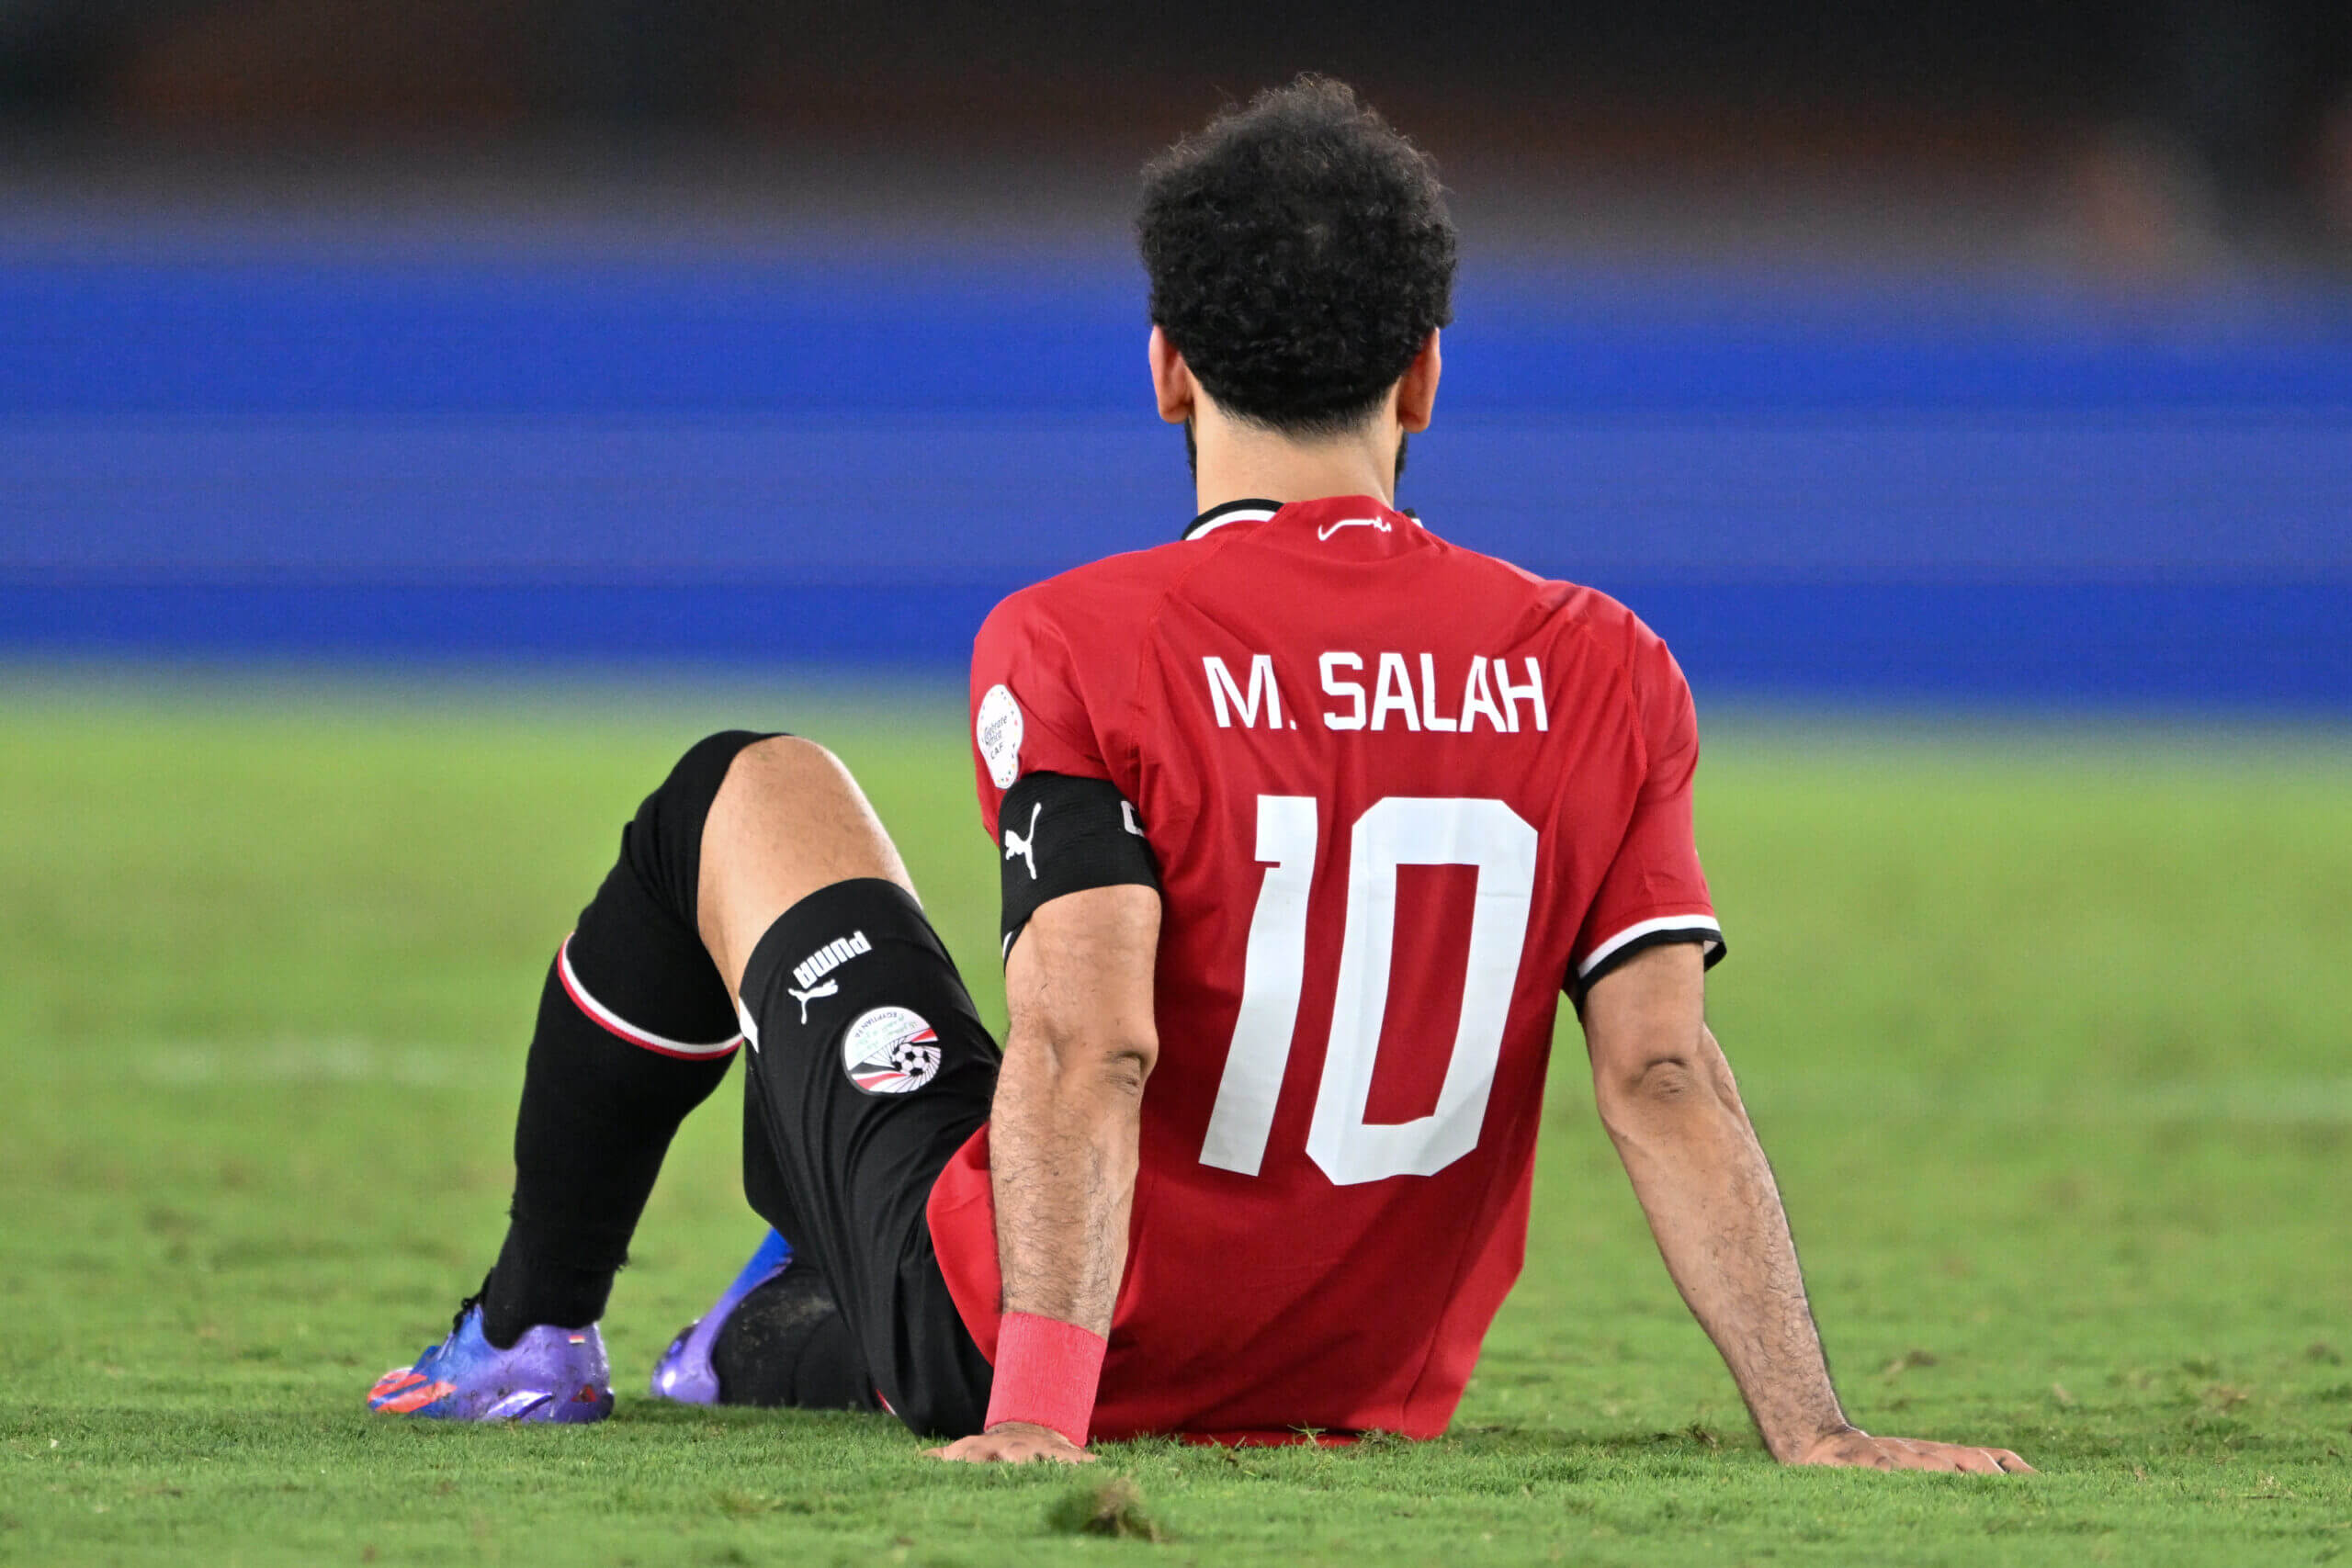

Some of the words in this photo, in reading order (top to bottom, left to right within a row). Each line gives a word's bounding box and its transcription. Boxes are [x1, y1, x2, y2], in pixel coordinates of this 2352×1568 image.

[1202, 654, 1297, 730] M.
[1318, 651, 1549, 733] SALAH
[991, 742, 1003, 760] CAF
[793, 931, 872, 989] PUMA
[1199, 794, 1539, 1186] 10
[861, 1011, 898, 1029] EGYPTIAN
